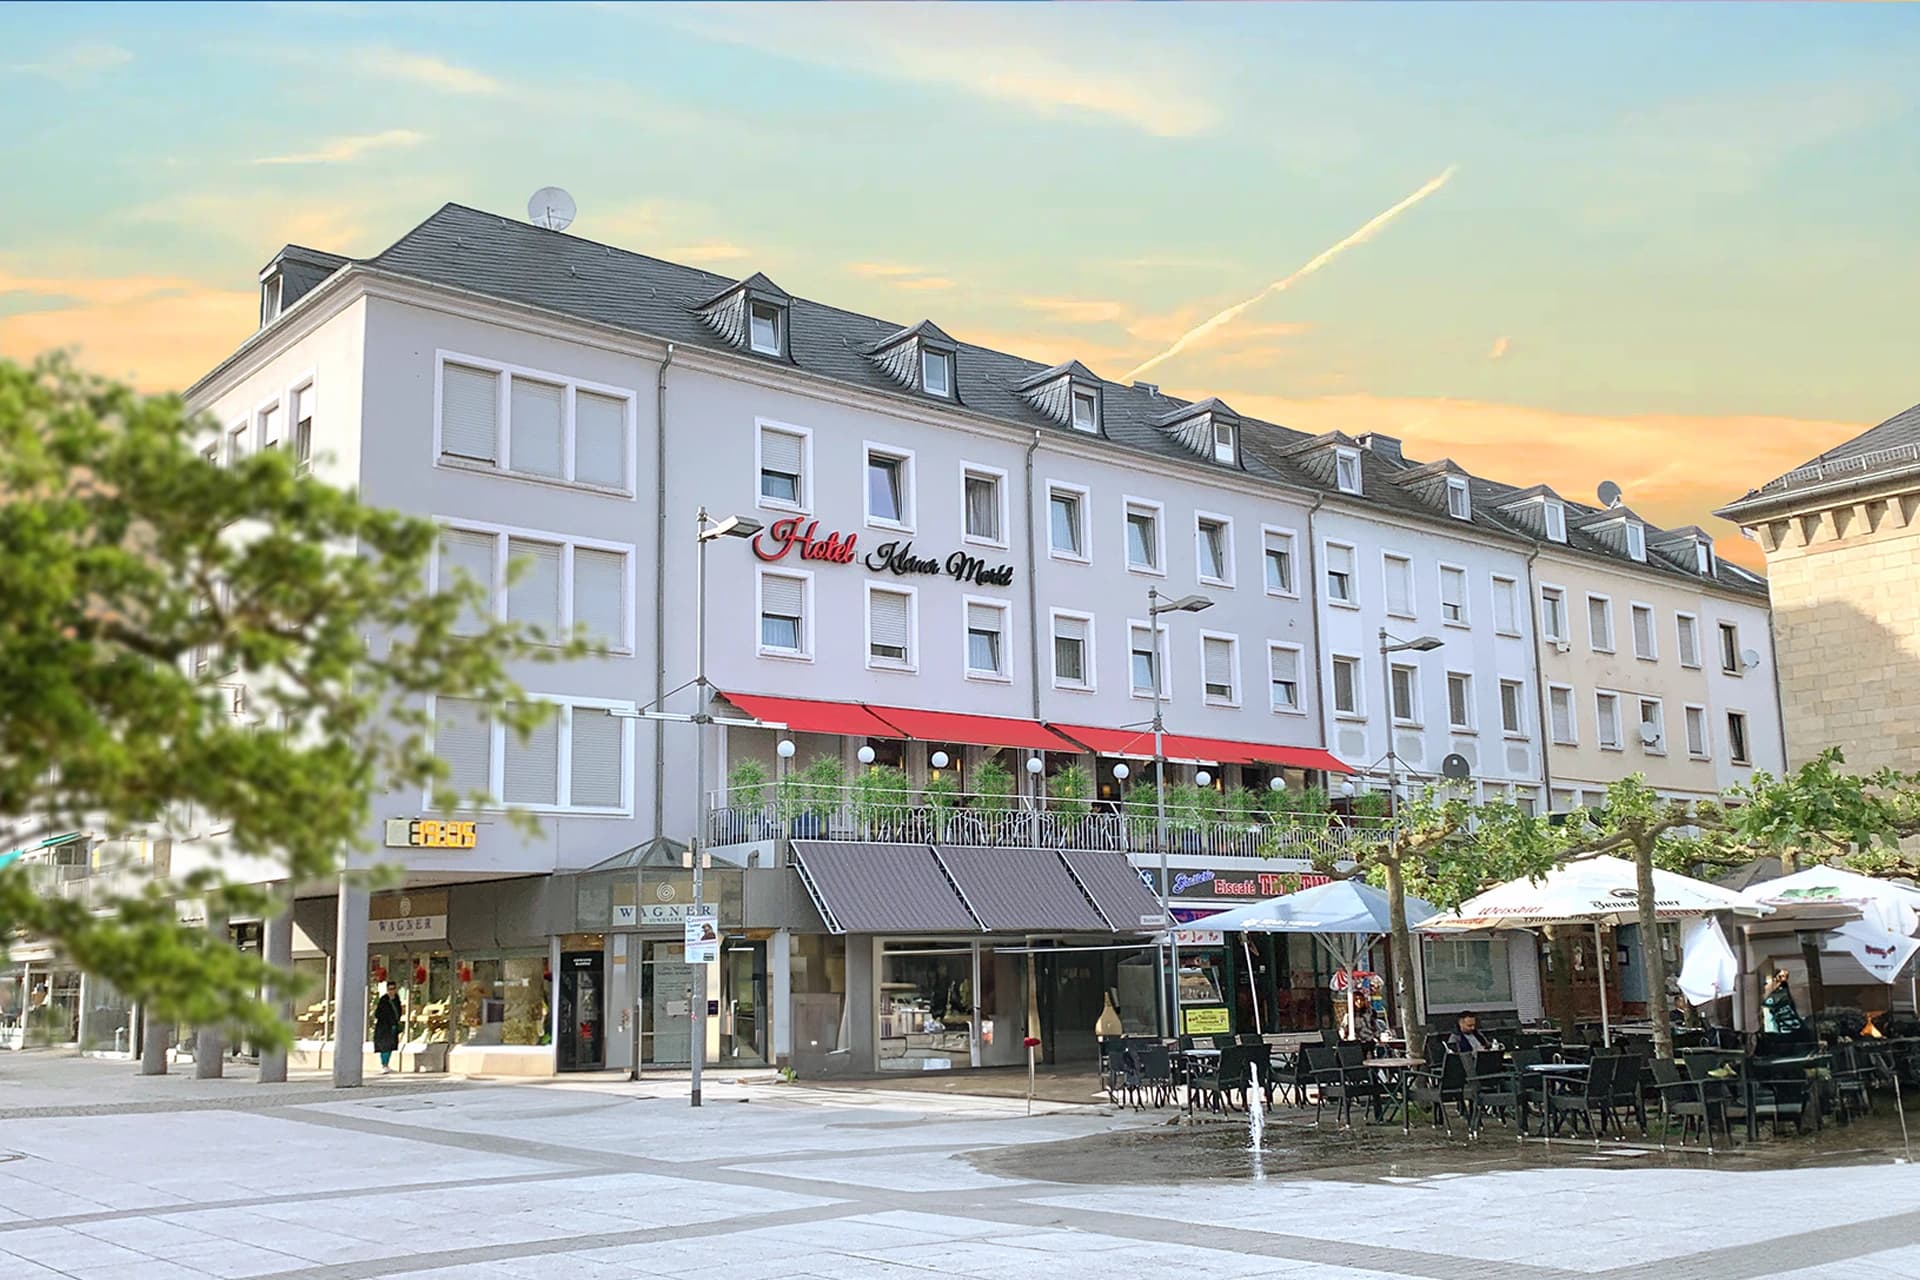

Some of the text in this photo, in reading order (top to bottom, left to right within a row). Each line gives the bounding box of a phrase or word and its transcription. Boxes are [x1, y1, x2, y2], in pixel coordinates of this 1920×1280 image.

[752, 516, 1014, 586] Hotel Kleiner Markt
[1213, 879, 1257, 895] Eiscafé
[619, 905, 712, 918] WAGNER
